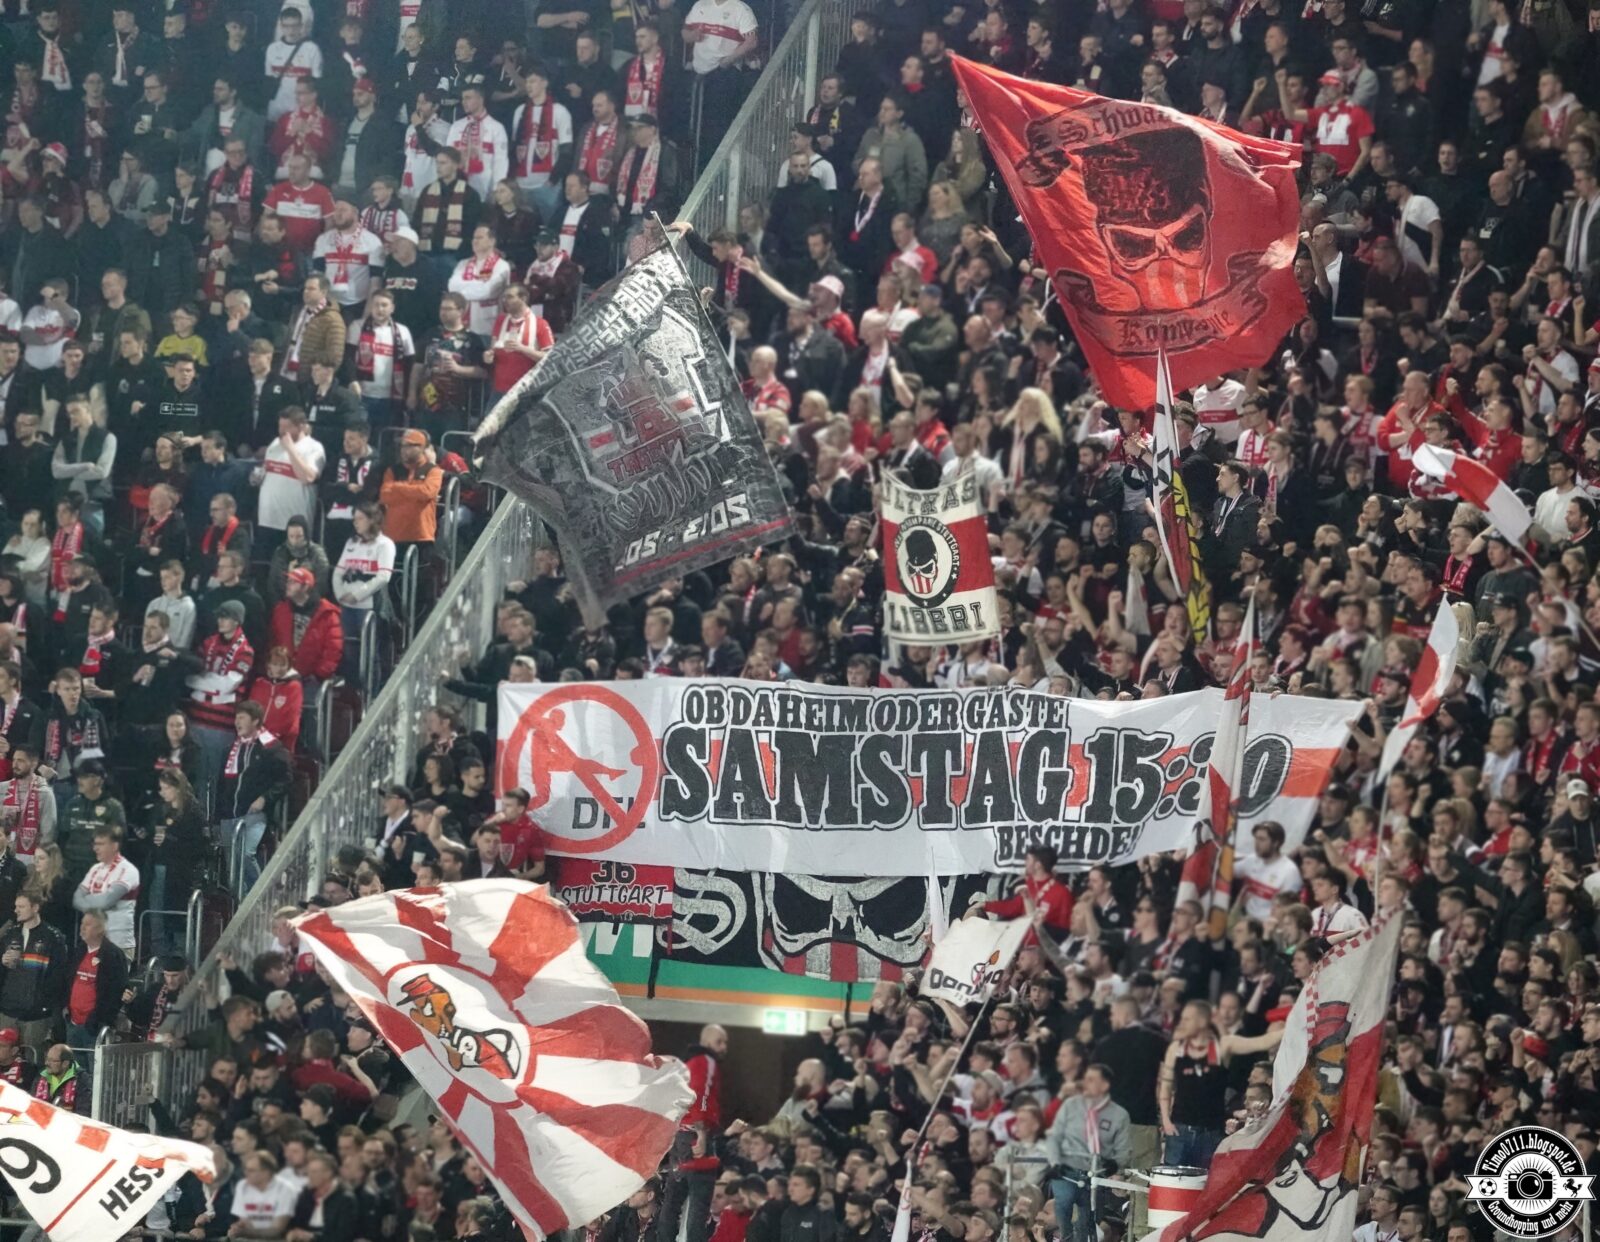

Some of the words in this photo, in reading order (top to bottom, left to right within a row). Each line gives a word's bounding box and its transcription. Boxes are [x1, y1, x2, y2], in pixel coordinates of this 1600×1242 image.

[935, 523, 961, 567] STUTTGART
[889, 601, 987, 634] LIBERI
[684, 688, 728, 726] OB
[727, 690, 871, 733] DAHEIM
[871, 694, 963, 733] ODER
[662, 725, 1070, 826] SAMSTAG
[591, 860, 636, 885] 36
[561, 884, 668, 906] STUTTGART
